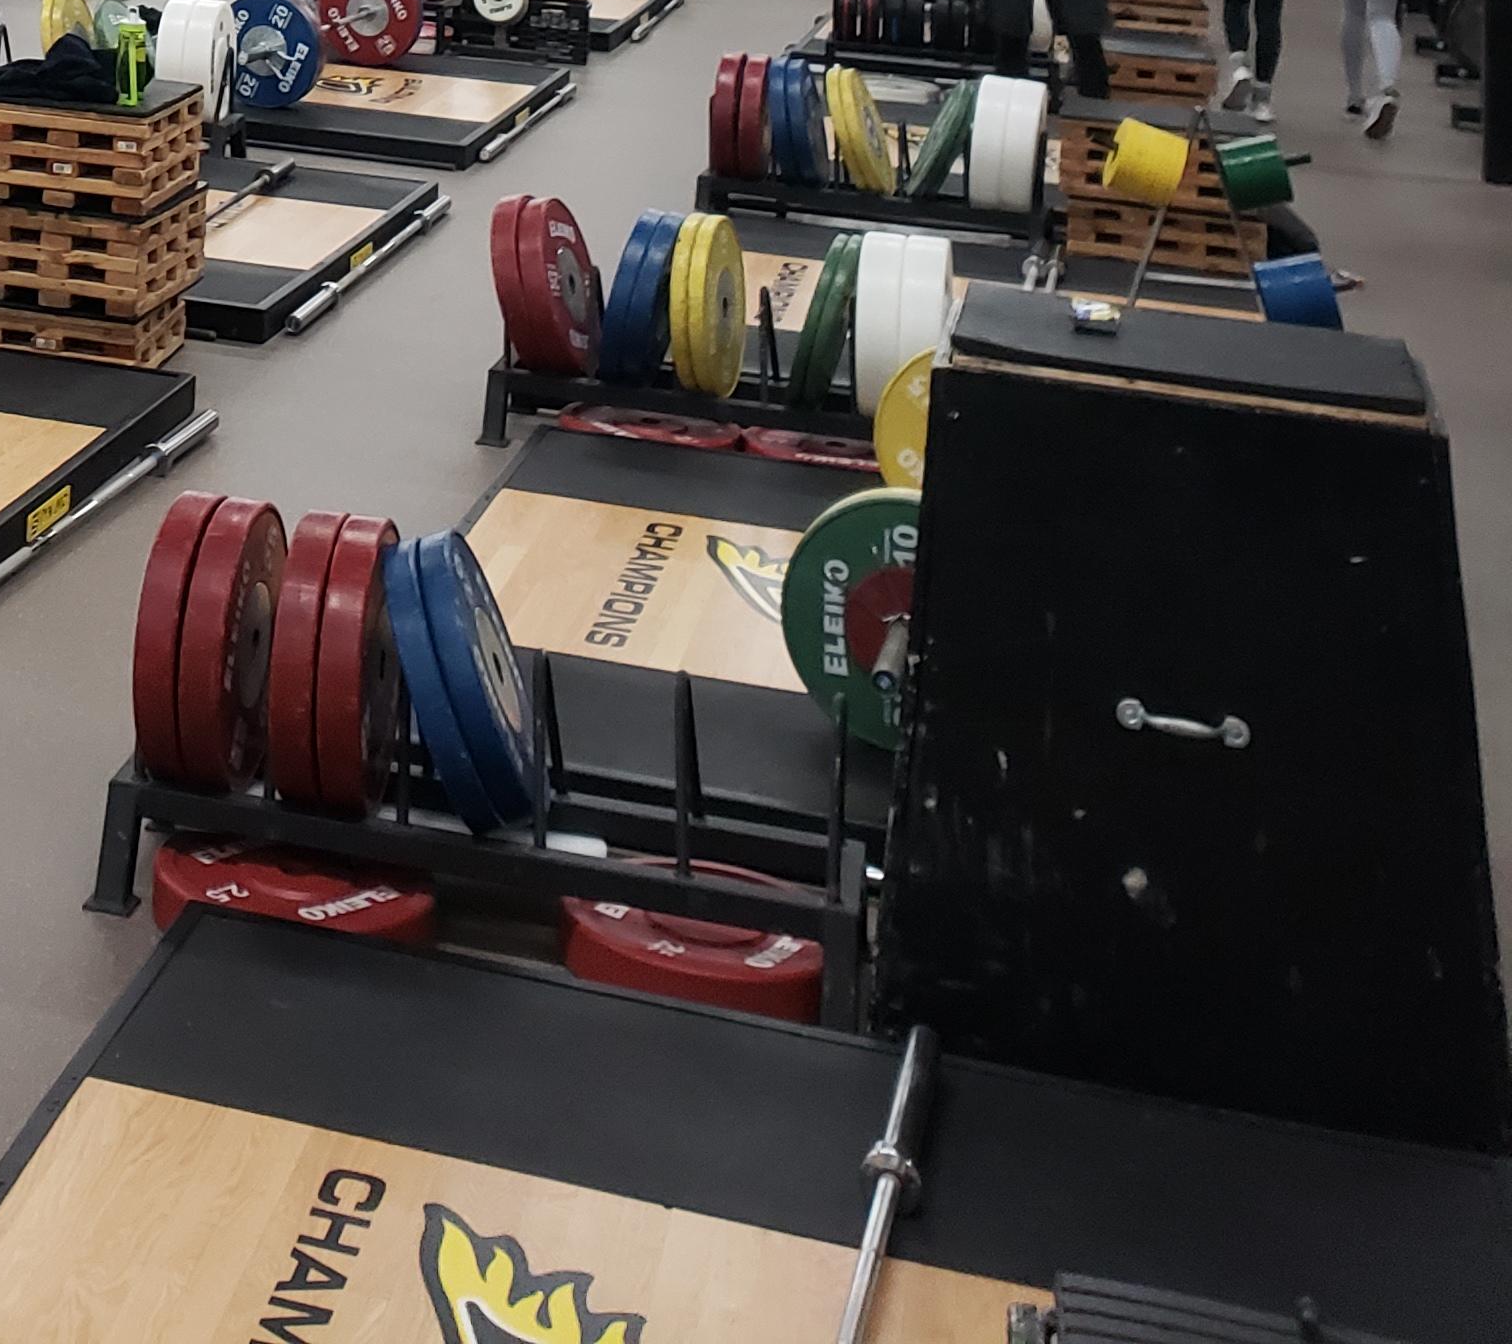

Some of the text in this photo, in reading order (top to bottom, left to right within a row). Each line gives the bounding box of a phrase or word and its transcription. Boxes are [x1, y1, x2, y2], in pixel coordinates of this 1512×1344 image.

[272, 5, 289, 28] 20
[239, 74, 256, 96] 20
[892, 524, 918, 569] 10
[584, 522, 683, 647] CHAMPIONS
[823, 559, 849, 677] ELEIKO
[205, 883, 250, 903] 25
[298, 885, 400, 921] ELEIKO
